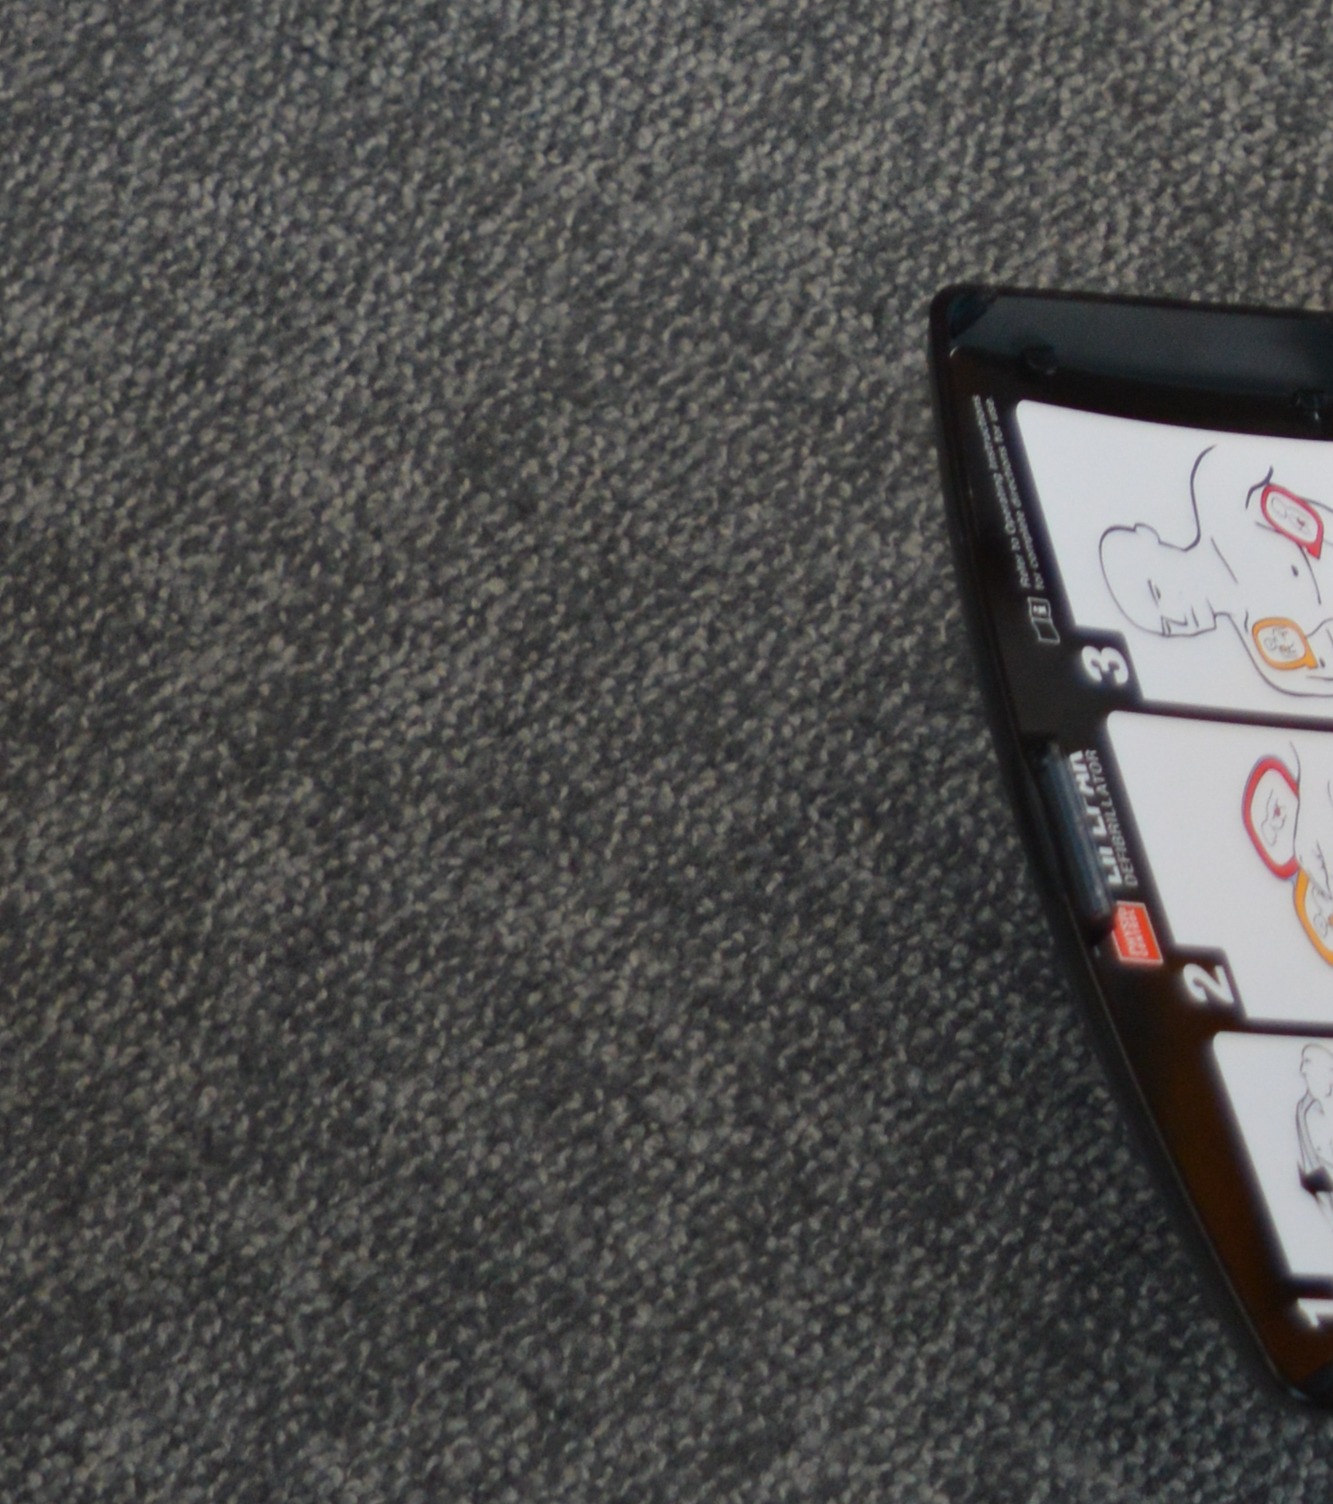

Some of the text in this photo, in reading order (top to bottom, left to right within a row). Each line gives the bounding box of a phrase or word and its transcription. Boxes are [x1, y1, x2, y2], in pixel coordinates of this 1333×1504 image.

[993, 424, 1003, 444] for
[972, 394, 1030, 588] Refer to Operating Instructions
[999, 445, 1021, 508] directions
[1016, 509, 1039, 569] complete
[1034, 571, 1044, 590] for
[1081, 645, 1129, 685] 3
[1084, 749, 1139, 887] DEFIBRILLATOR
[1182, 962, 1235, 1006] 2
